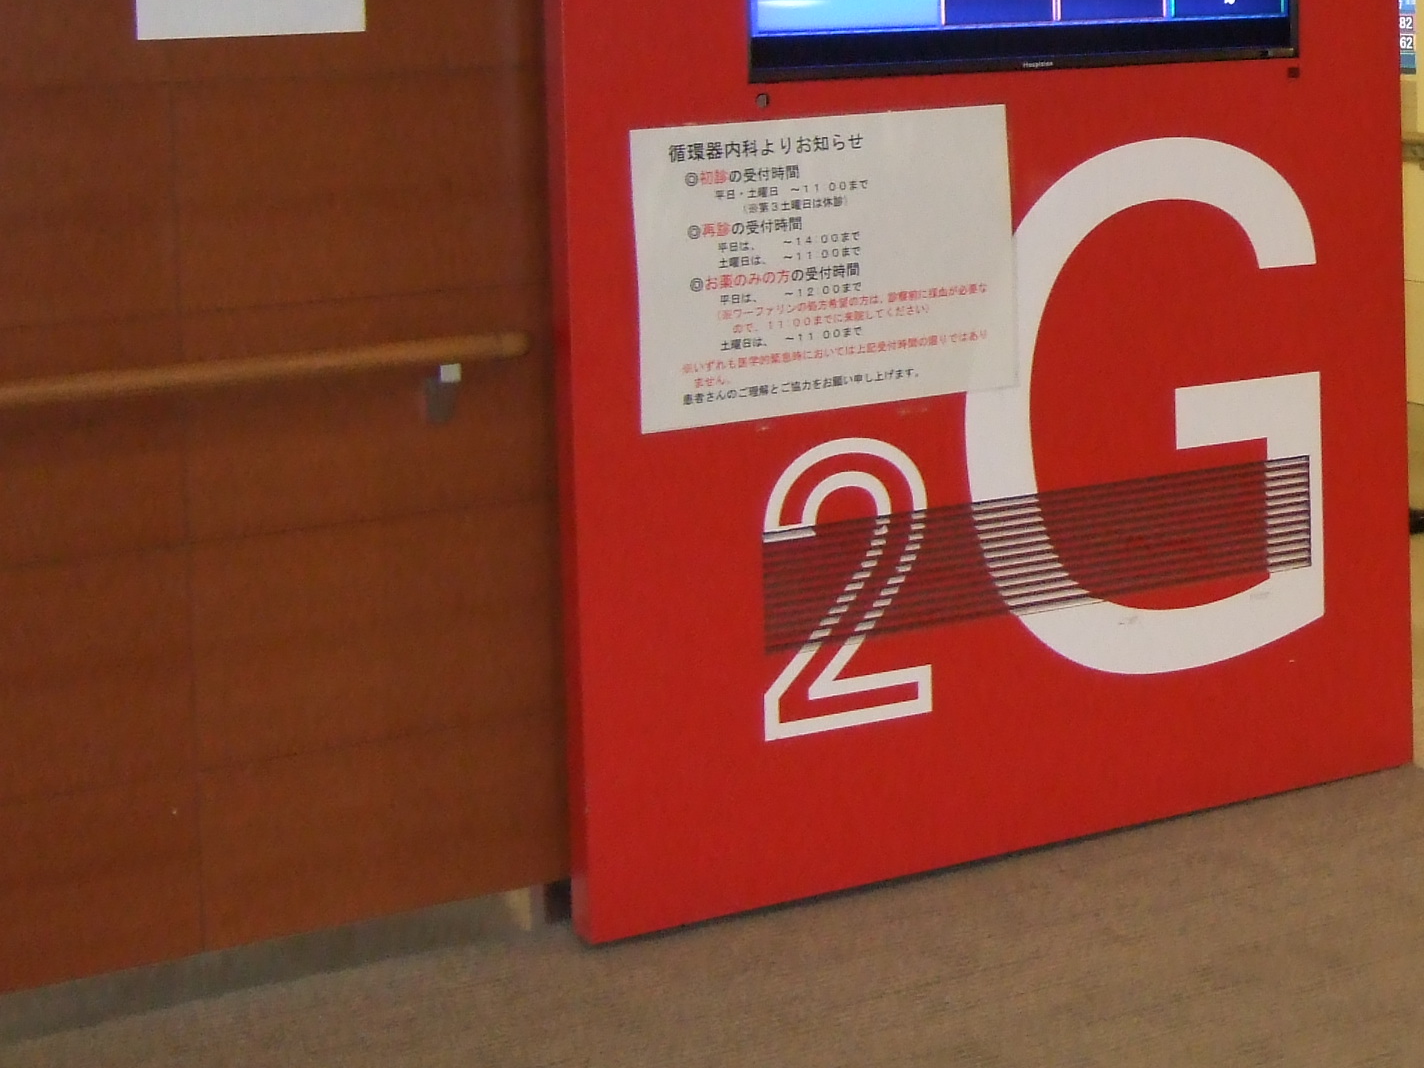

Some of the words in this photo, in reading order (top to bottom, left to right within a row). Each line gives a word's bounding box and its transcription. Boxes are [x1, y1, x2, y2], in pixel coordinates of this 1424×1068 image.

[668, 133, 865, 163] 循環器内科よりお知らせ
[762, 135, 1325, 742] 2G
